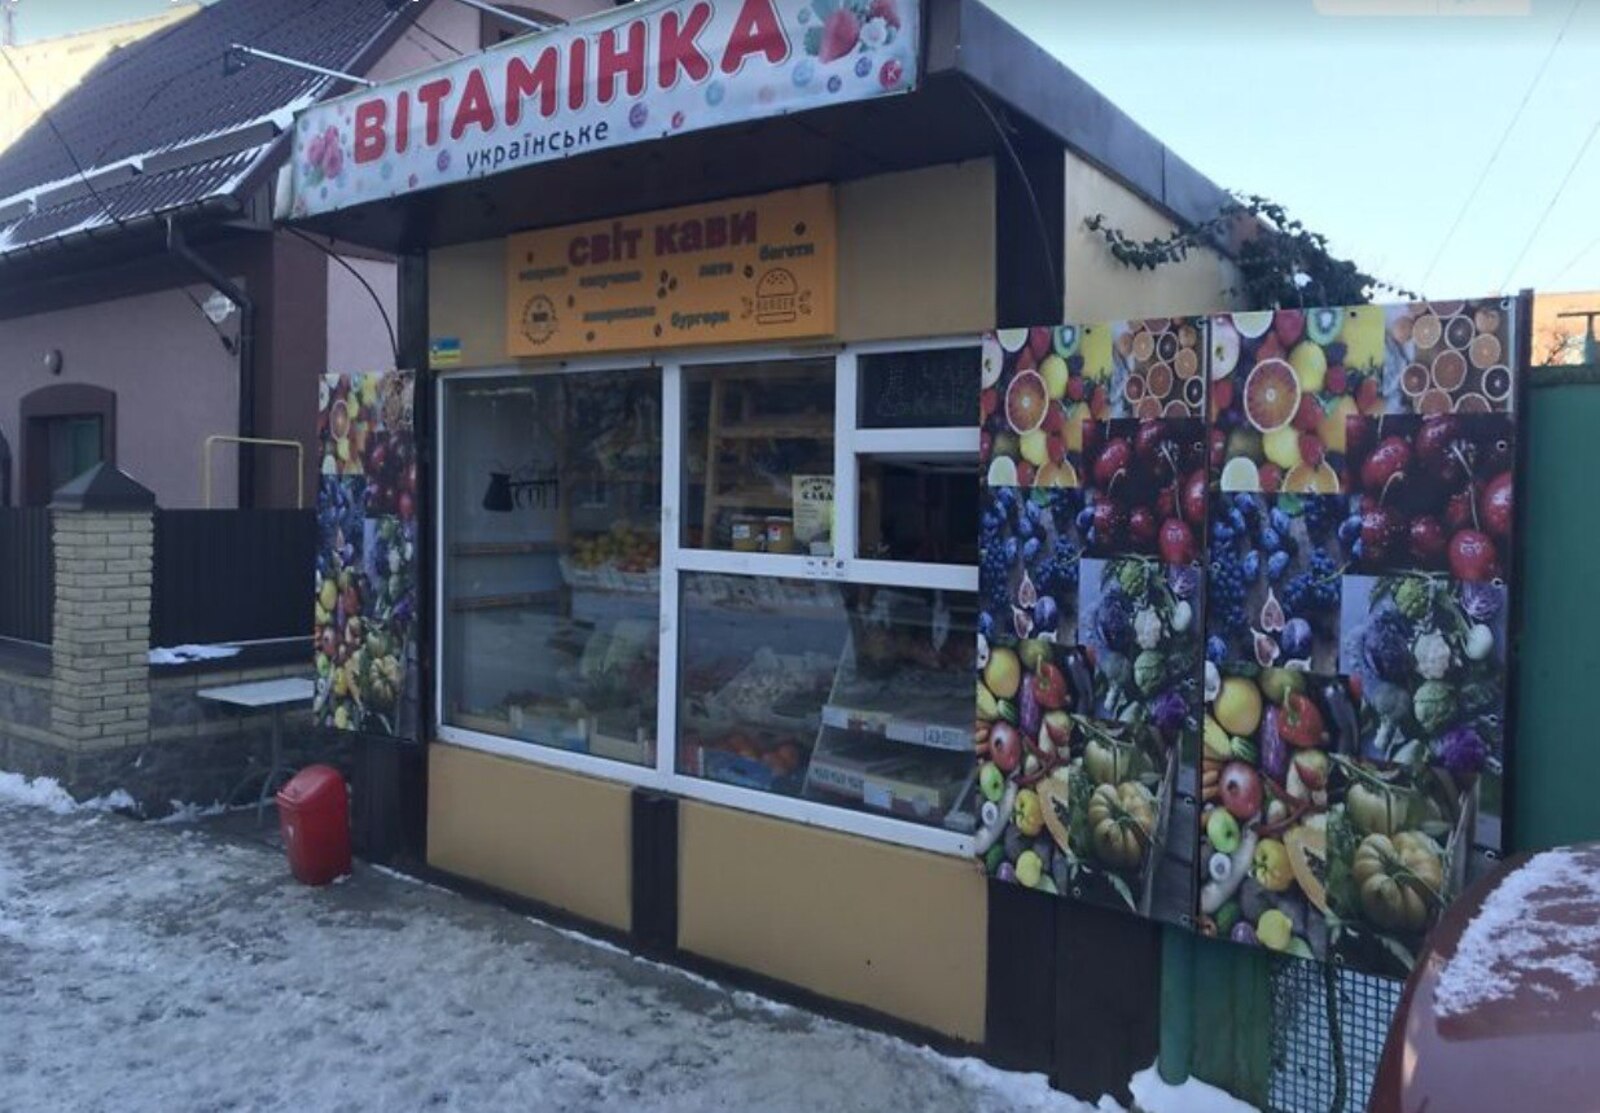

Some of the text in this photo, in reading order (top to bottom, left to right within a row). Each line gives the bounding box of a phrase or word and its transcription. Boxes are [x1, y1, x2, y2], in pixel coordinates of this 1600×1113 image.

[353, 0, 790, 165] ВІТАМІНКА
[465, 119, 610, 174] українське
[568, 210, 757, 267] світ кави
